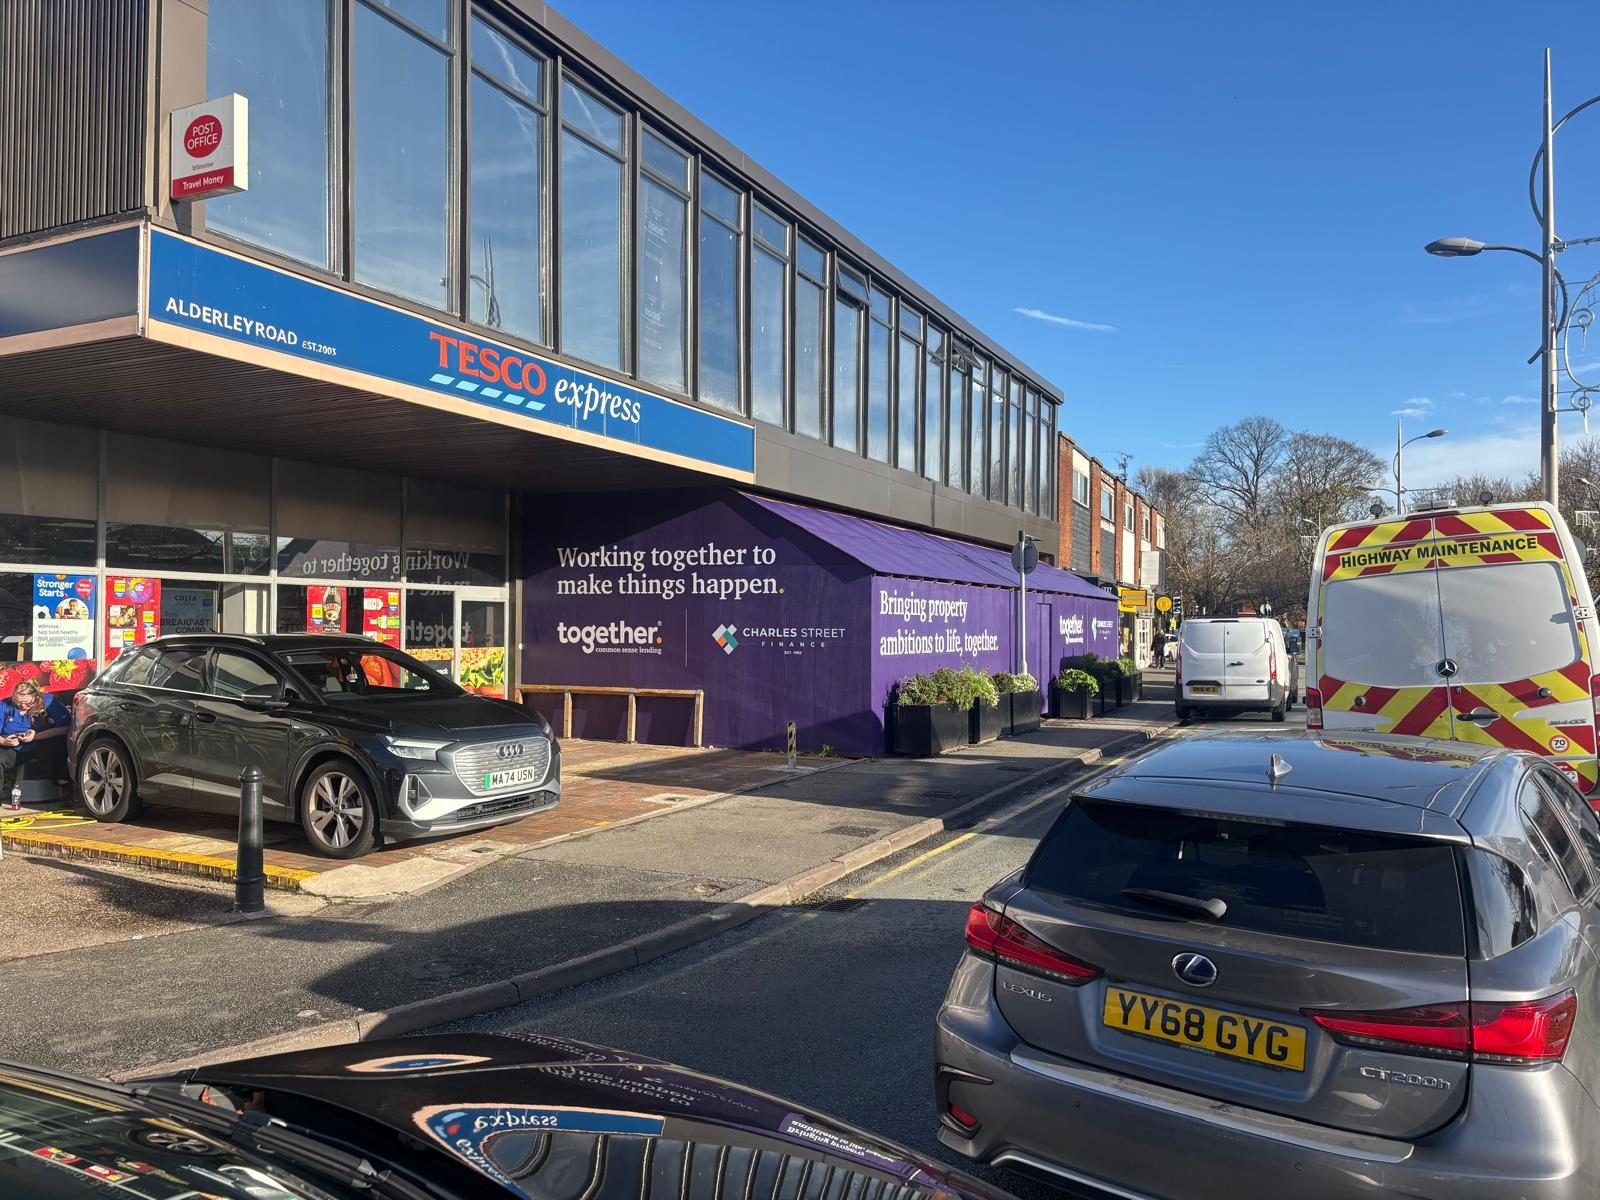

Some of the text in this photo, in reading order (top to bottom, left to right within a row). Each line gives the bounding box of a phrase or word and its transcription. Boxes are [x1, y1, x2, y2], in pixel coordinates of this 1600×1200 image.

[192, 122, 215, 137] POST
[187, 133, 218, 150] OFFICE
[182, 175, 224, 190] Travel Money
[302, 340, 337, 356] EST.2003
[429, 331, 641, 424] TESCO express
[557, 543, 776, 572] Working together to
[1341, 537, 1538, 568] HIGHWAY MAINTENANCE
[37, 579, 74, 590] Stronger
[39, 588, 65, 597] Starts
[557, 572, 785, 600] make things happen.
[879, 589, 968, 623] Bringing property
[160, 618, 209, 626] BREAKFAST
[742, 627, 846, 638] CHARLES STREET
[639, 646, 662, 655] lending
[879, 628, 999, 657] ambitions to life, together.
[492, 769, 533, 786] MA74 USN
[1003, 981, 1053, 1002] LEXUS
[1118, 992, 1289, 1062] YY68 GYG
